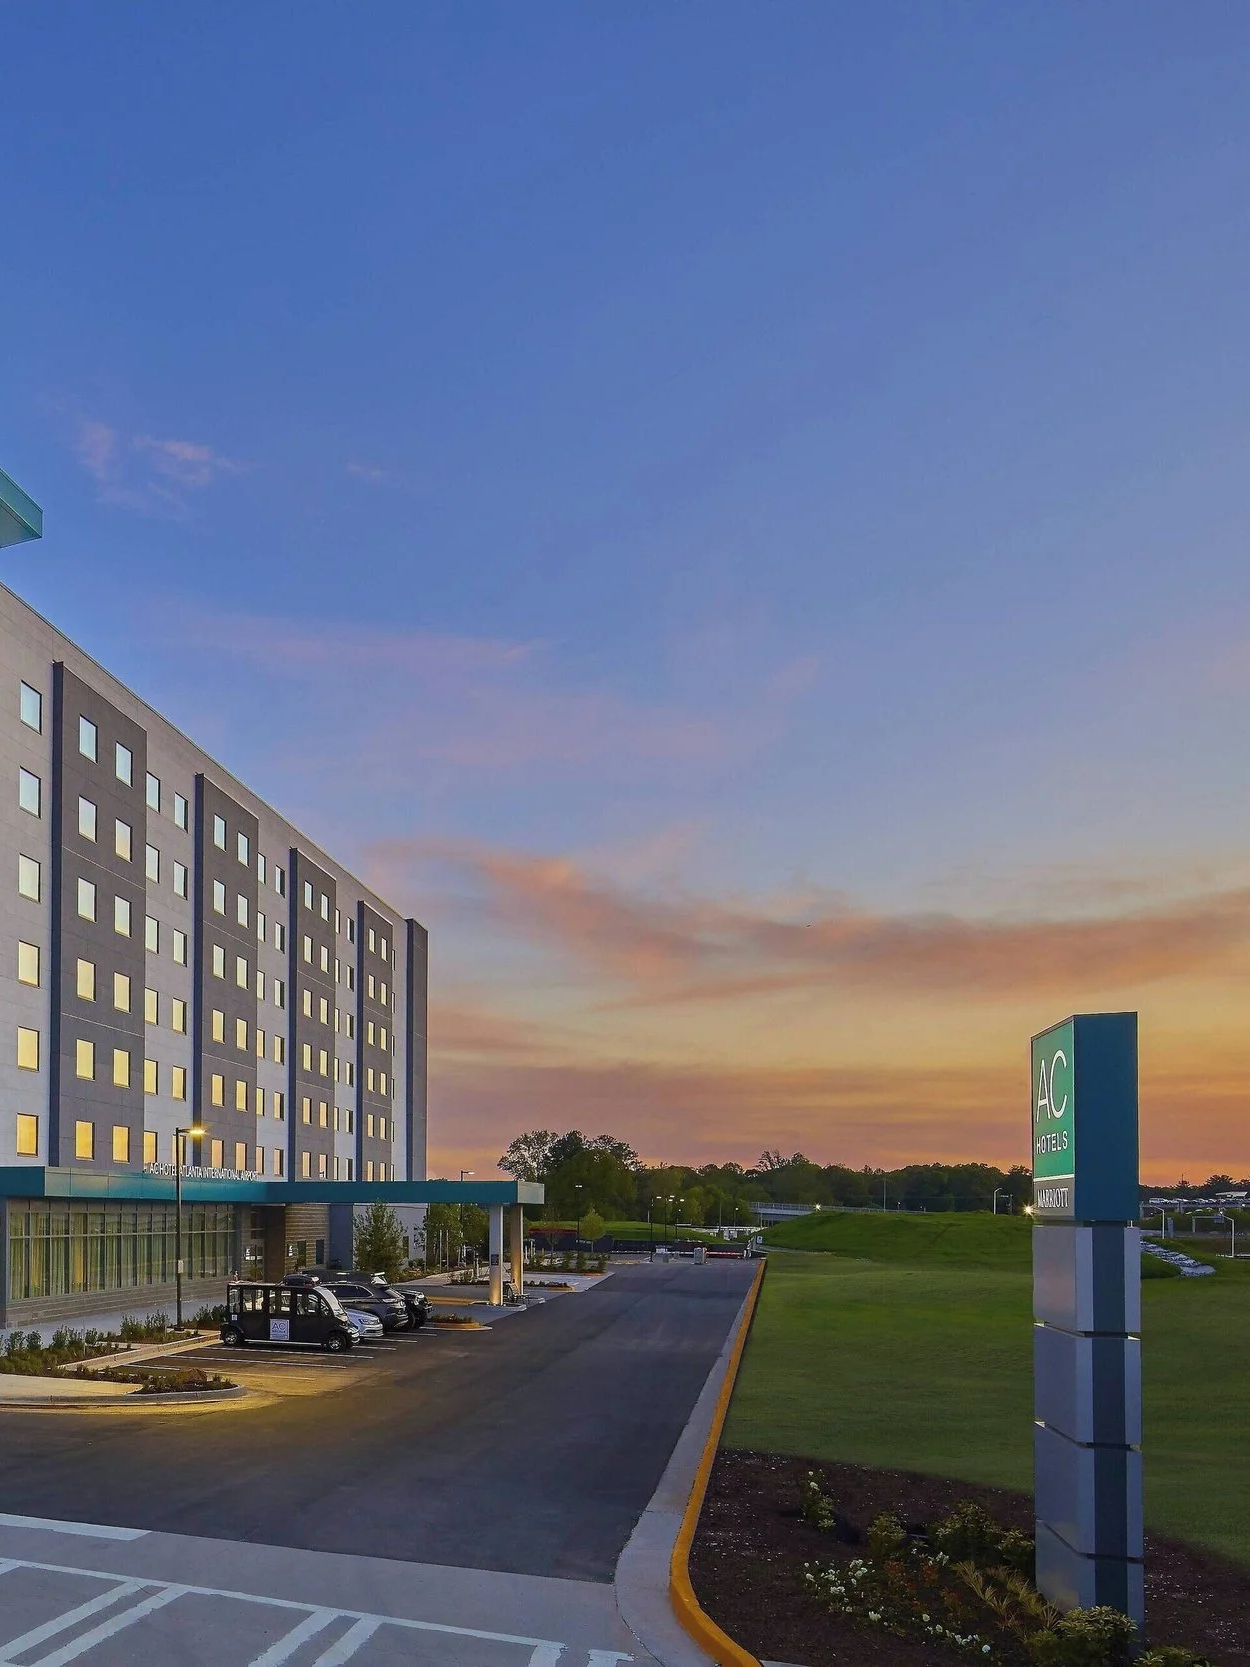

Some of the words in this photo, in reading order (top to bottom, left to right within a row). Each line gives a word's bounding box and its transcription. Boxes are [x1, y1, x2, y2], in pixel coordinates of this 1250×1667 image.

[1036, 1049, 1067, 1123] AC
[1036, 1130, 1068, 1155] HOTELS
[149, 1162, 159, 1175] AC
[159, 1163, 177, 1176] HOTEL
[1037, 1187, 1069, 1208] MARRIOTT
[272, 1322, 286, 1330] AC
